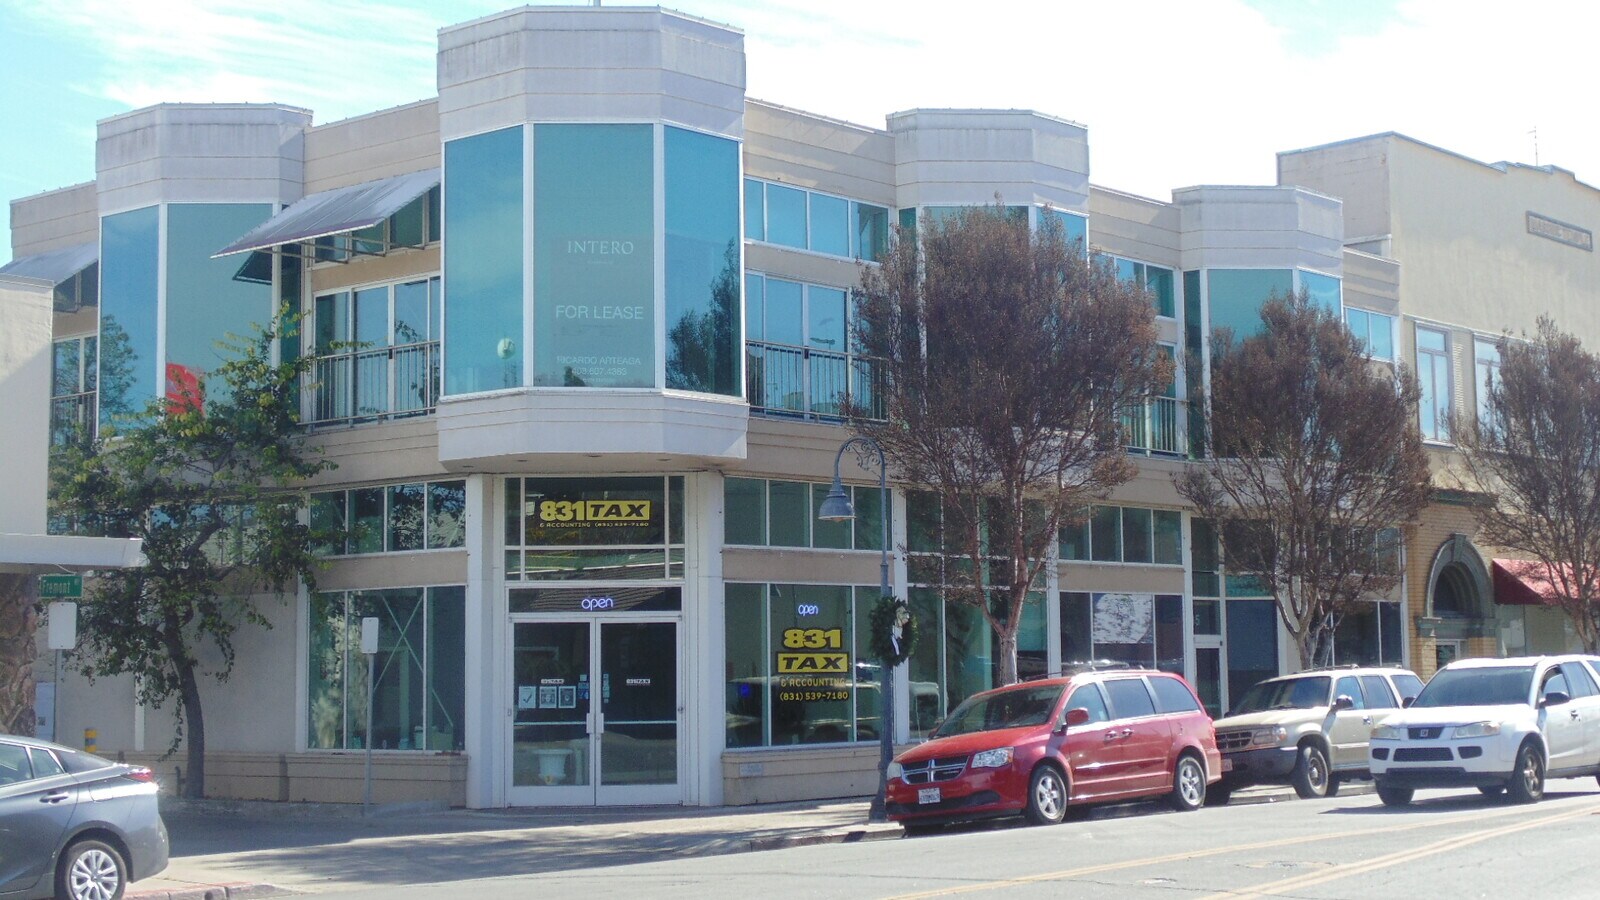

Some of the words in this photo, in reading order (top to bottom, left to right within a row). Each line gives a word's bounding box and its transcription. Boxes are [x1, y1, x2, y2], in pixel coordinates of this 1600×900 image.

[567, 240, 634, 255] INTERO
[556, 305, 588, 319] FOR
[593, 306, 644, 320] LEASE
[539, 500, 585, 521] 831
[590, 504, 646, 518] TAX
[43, 580, 71, 594] Fremont
[581, 598, 614, 611] open
[798, 604, 819, 616] open
[783, 628, 841, 649] 831
[782, 657, 843, 670] TAX
[789, 677, 846, 687] ACCOUNTING
[779, 691, 804, 701] (831)
[805, 691, 848, 700] 539-7180
